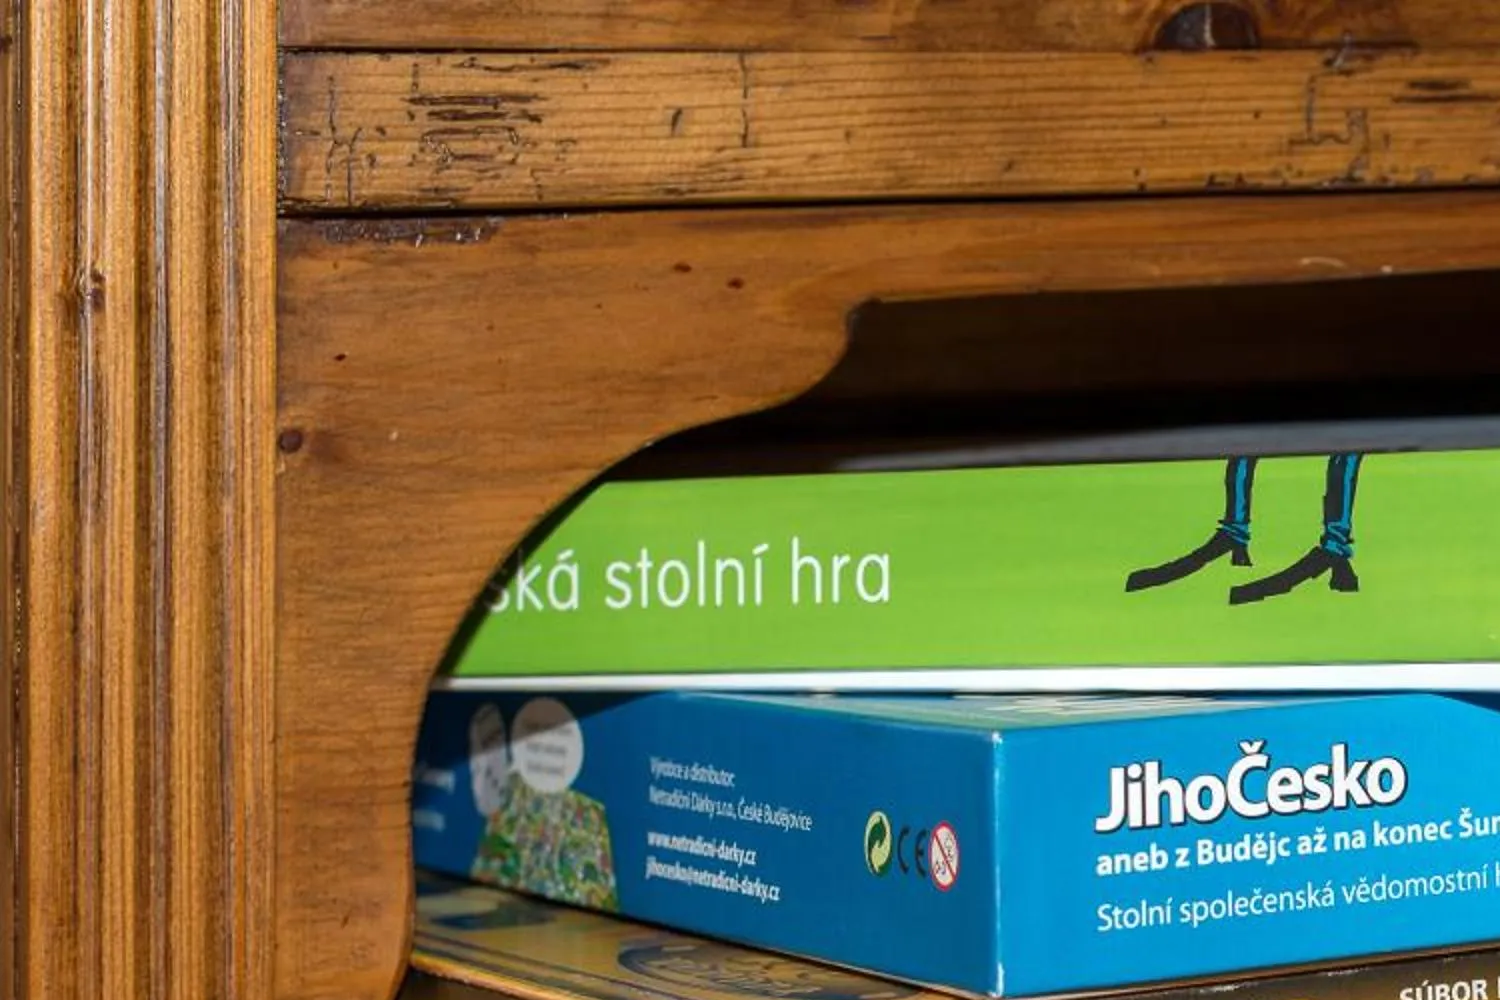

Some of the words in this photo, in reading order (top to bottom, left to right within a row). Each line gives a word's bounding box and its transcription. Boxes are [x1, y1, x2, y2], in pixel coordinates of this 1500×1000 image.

[604, 539, 770, 609] stolní
[791, 535, 891, 604] hra
[738, 796, 763, 824] České
[1094, 739, 1408, 833] JihoČesko
[647, 830, 757, 868] www.netradicni-darky.cz
[1096, 847, 1169, 876] aneb
[1175, 848, 1190, 869] z
[1197, 833, 1291, 870] Budějc
[1297, 825, 1329, 858] až
[1333, 830, 1367, 853] na
[1373, 816, 1453, 848] konec
[1096, 896, 1173, 932] Stolní
[1180, 881, 1335, 928] společenská
[1341, 863, 1489, 905] vědomostní
